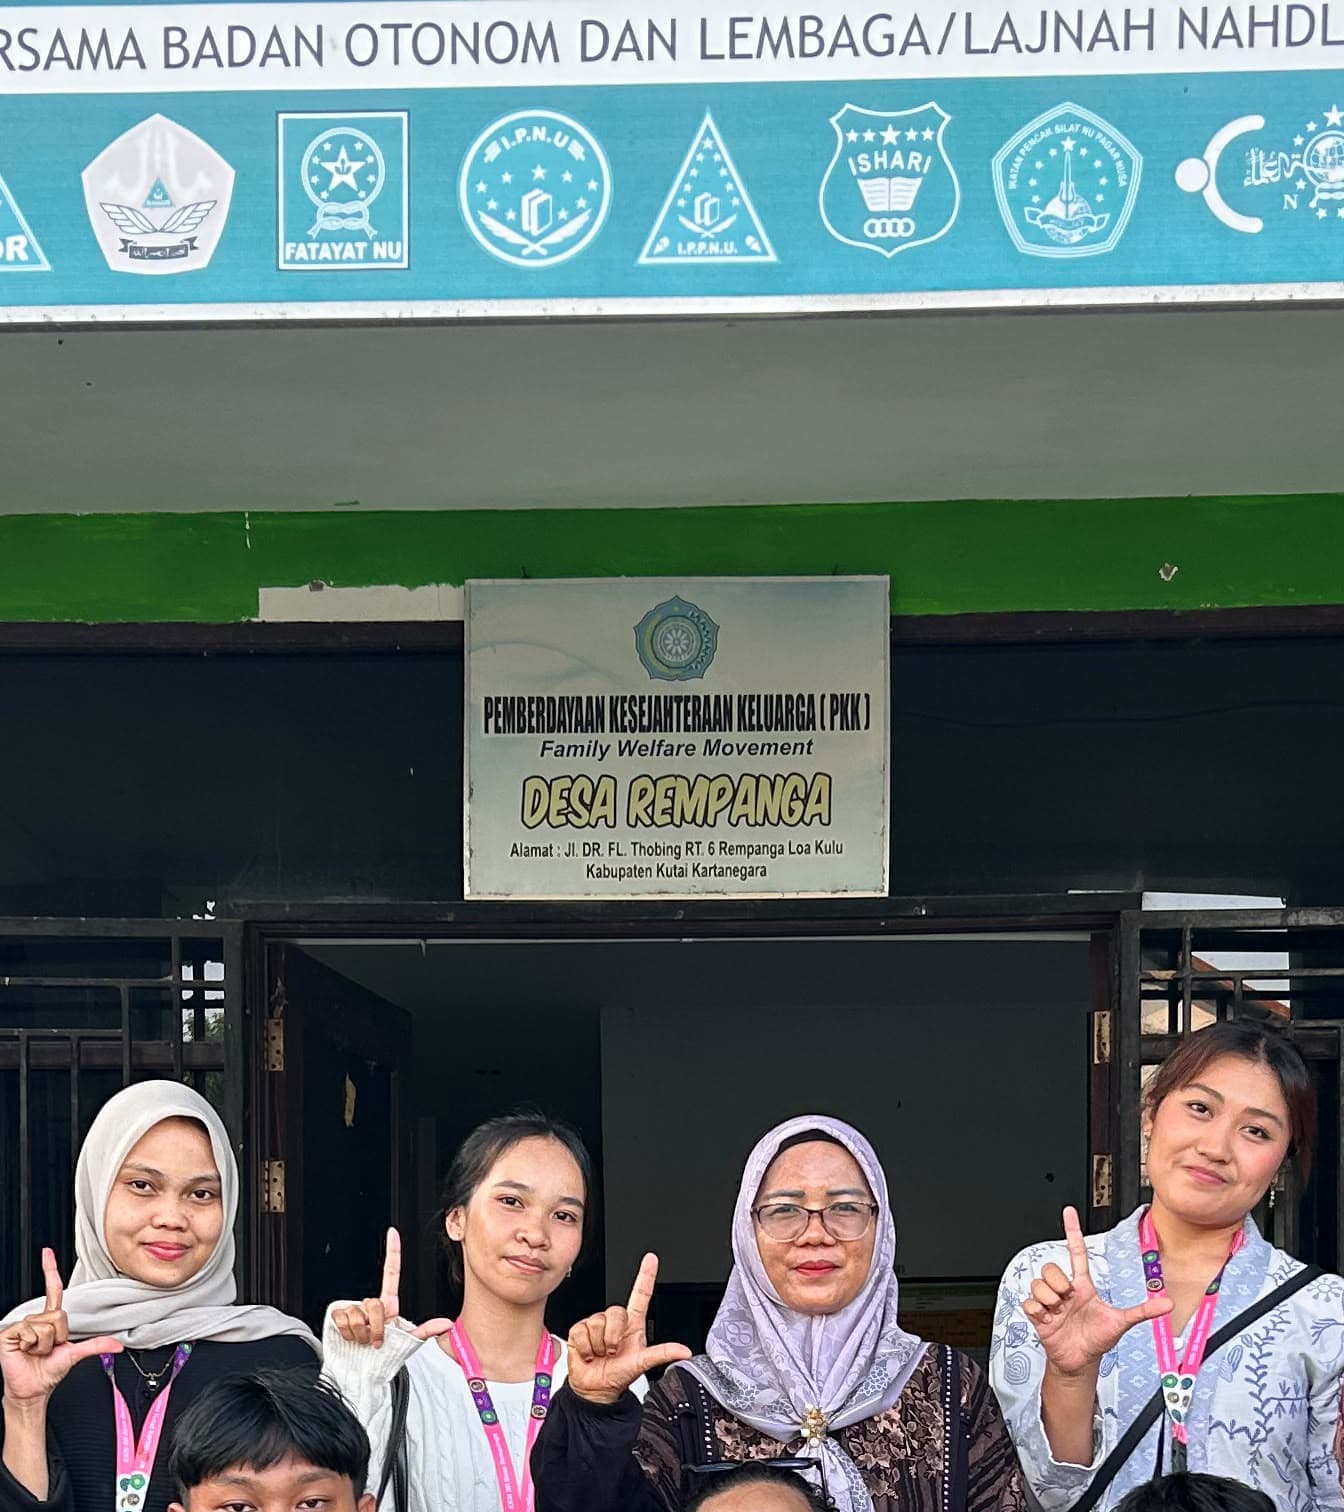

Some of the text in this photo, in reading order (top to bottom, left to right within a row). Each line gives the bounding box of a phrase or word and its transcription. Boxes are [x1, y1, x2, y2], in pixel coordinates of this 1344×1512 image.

[164, 26, 324, 69] BADAN
[344, 22, 558, 66] OTONOM
[579, 20, 677, 63] DAN
[698, 9, 1161, 60] LEMBAGA/LAJNAH
[1019, 129, 1053, 156] PENCAK
[1055, 123, 1081, 134] SILAT
[1082, 126, 1093, 137] NU
[1095, 131, 1121, 160] PAGAR
[848, 150, 932, 176] ISHARI
[1284, 193, 1298, 209] N
[285, 240, 402, 261] FATAYAT NU
[484, 696, 605, 733] PEMBERDAYAAN
[609, 695, 732, 733] KESEJAHTERAAN
[737, 694, 816, 731] KELUARGA
[540, 738, 813, 761] Family Welfare Movement
[521, 773, 832, 829] DESA REMPANGA
[510, 842, 553, 858] Alamat
[582, 842, 604, 858] DR.
[608, 842, 627, 858] FL.
[631, 841, 681, 860] Thobing
[685, 841, 704, 857] RT.
[707, 841, 715, 857] 6
[719, 841, 785, 861] Rempanga
[788, 841, 811, 856] Loa
[815, 840, 843, 855] Kulu
[586, 862, 767, 882] Kabupaten Kutai Kartanegara
